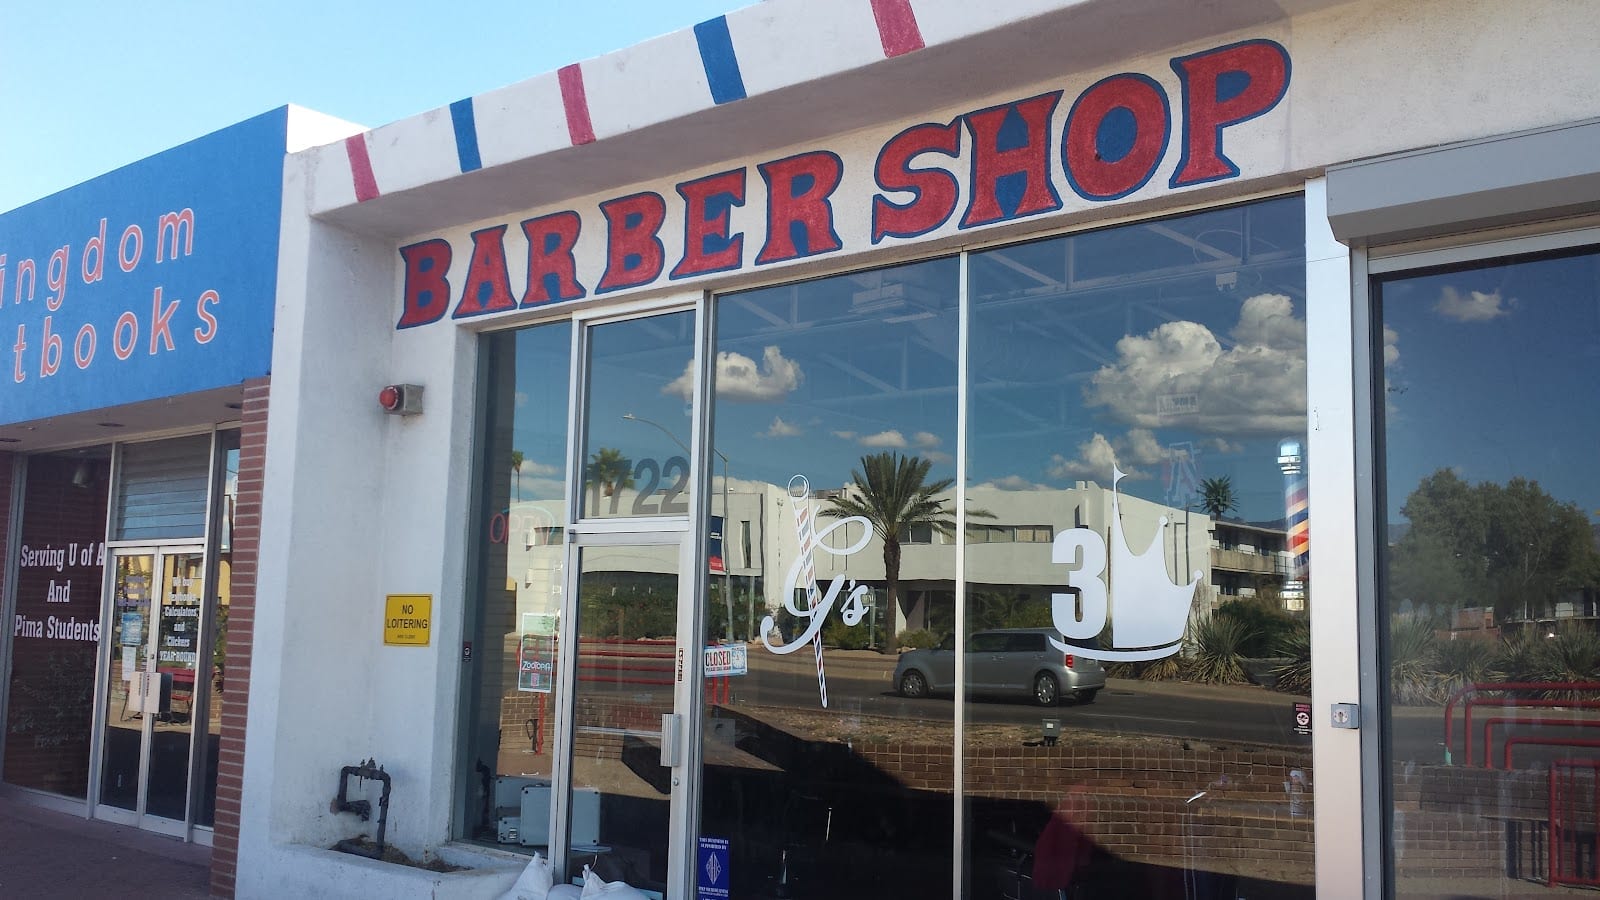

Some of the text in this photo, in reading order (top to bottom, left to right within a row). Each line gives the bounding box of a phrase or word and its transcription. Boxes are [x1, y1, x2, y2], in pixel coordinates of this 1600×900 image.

[397, 39, 1292, 330] BARBER SHOP
[0, 208, 195, 312] ingdom
[13, 287, 220, 383] tbooks
[587, 455, 690, 517] 1722
[20, 542, 105, 572] Serving U of A
[47, 579, 71, 603] And
[1051, 528, 1108, 640] 3
[14, 614, 43, 638] Pima
[46, 615, 101, 642] Students
[402, 604, 414, 615] NO
[705, 651, 731, 667] CLOSED
